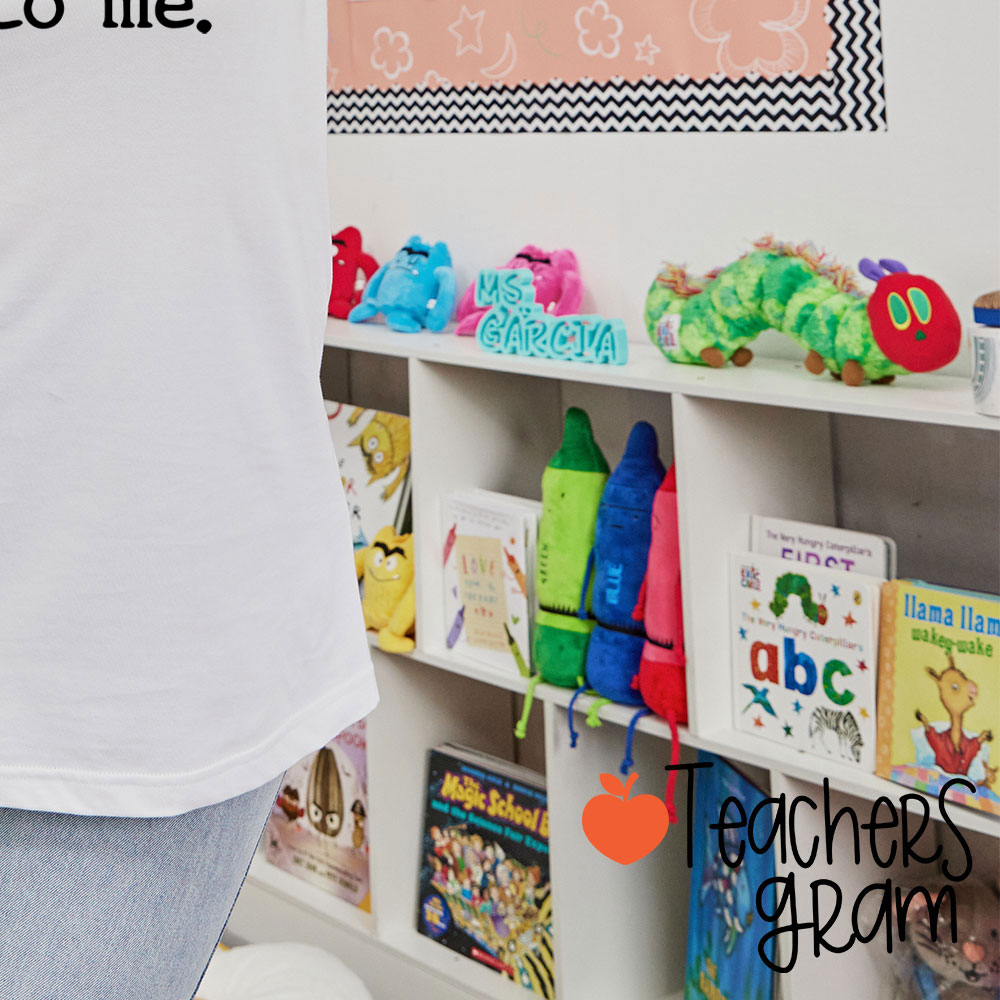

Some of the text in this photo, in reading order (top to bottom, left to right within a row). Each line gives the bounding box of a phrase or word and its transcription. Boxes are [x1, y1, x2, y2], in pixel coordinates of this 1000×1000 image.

[477, 310, 619, 363] GARCIA
[904, 593, 1000, 637] llama llam
[750, 637, 856, 706] abc
[440, 771, 487, 811] Magic
[486, 788, 540, 833] School
